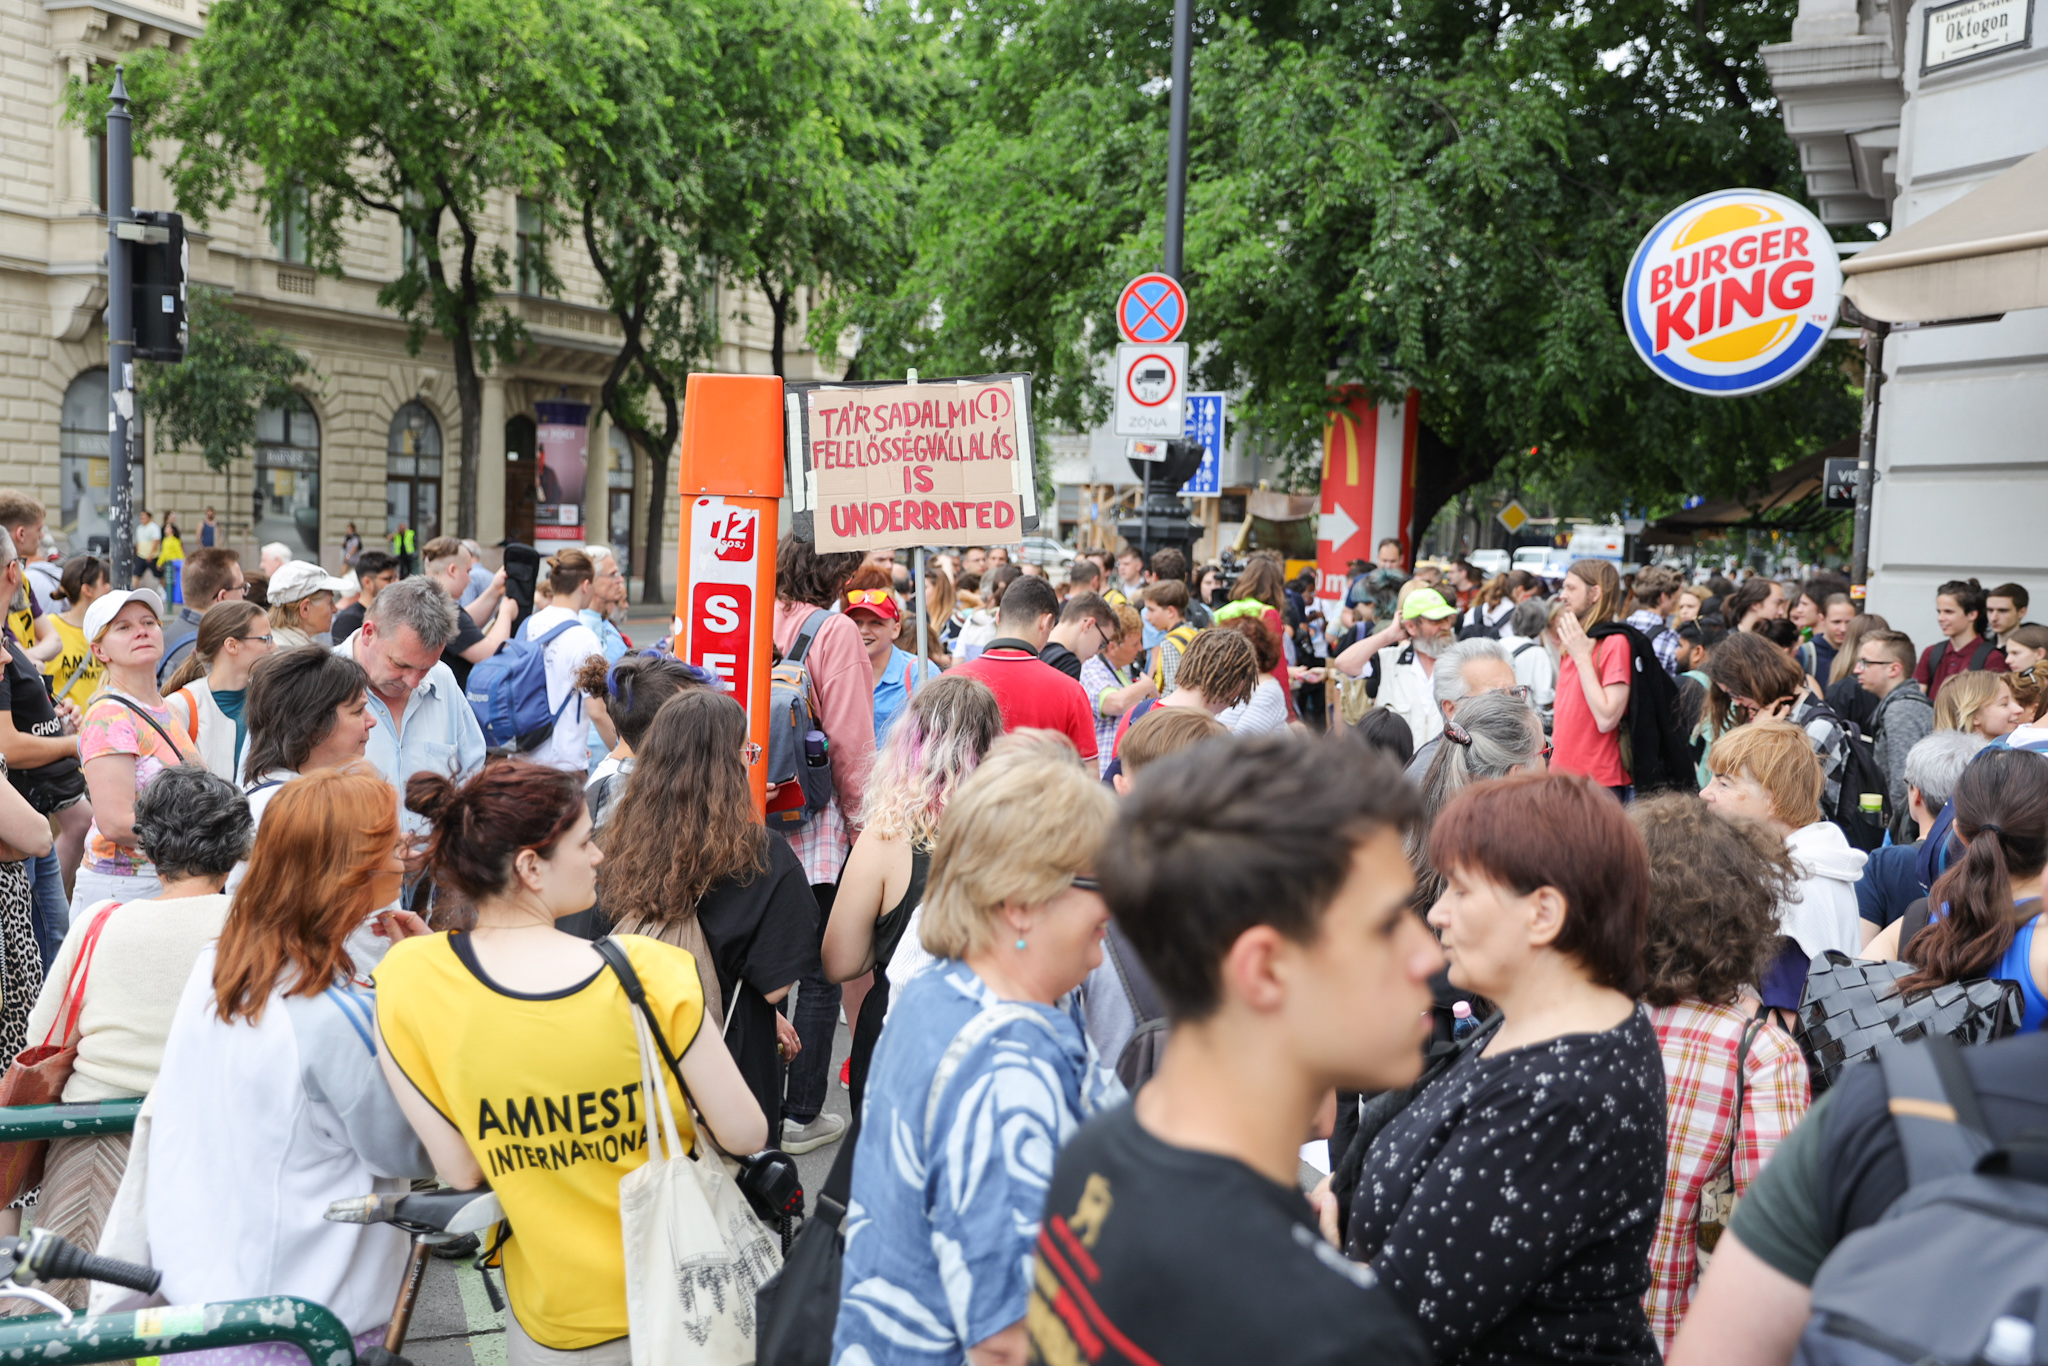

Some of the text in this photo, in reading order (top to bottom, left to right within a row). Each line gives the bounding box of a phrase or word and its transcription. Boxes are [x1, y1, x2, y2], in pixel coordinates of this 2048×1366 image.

[1946, 13, 2008, 43] Oktogon
[1650, 226, 1809, 304] BURGER
[1656, 260, 1815, 353] KING
[813, 426, 1014, 470] FELELŐSSÉGVÁLLALÁS
[903, 464, 934, 494] IS
[1837, 469, 1860, 484] VIS
[830, 499, 1016, 538] UNDERRATED
[31, 716, 61, 736] GHOS
